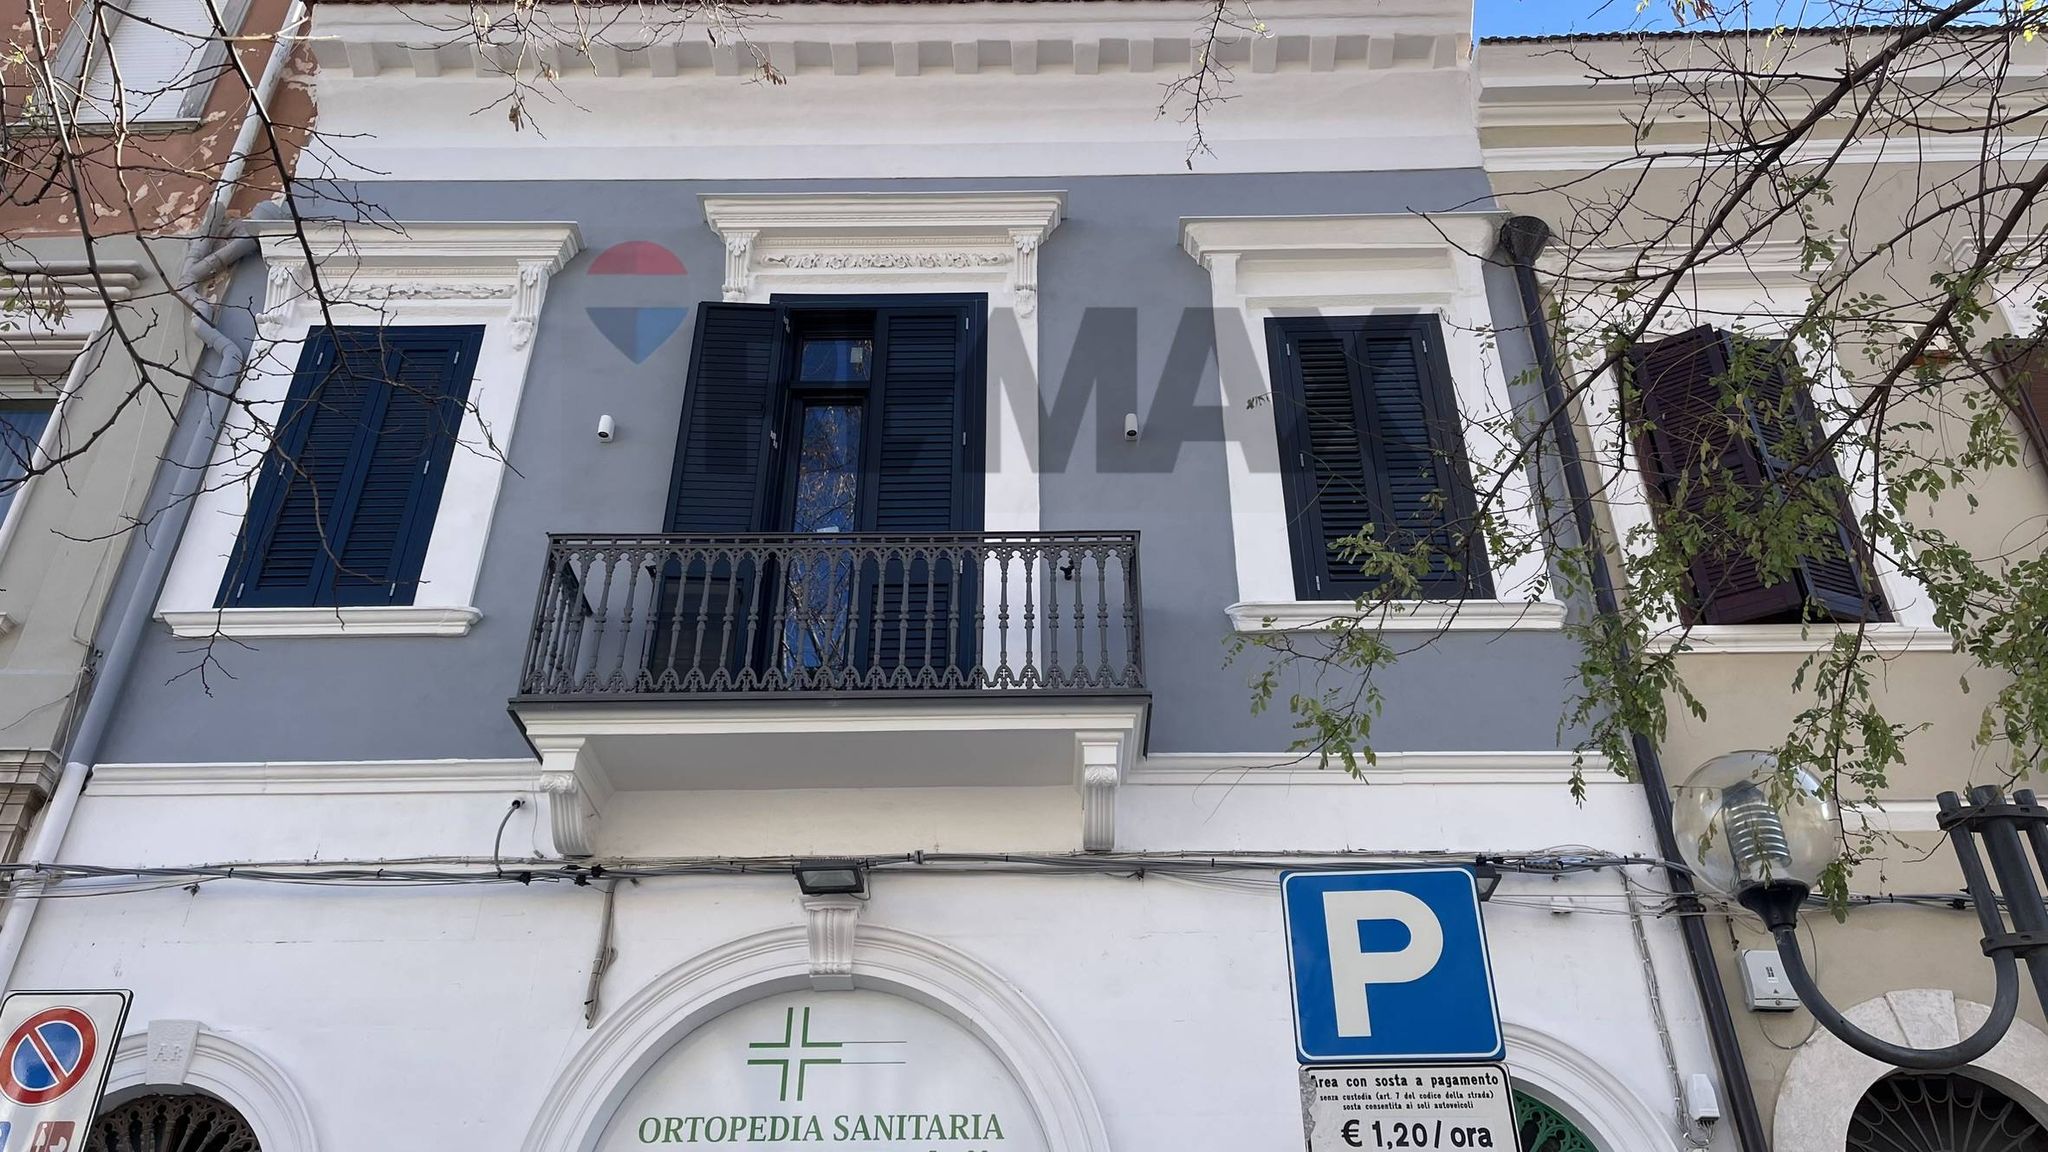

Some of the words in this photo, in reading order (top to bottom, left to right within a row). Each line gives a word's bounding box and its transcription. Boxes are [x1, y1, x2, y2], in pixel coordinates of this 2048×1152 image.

[1322, 890, 1443, 1037] P
[1346, 1077, 1367, 1087] con
[1375, 1074, 1408, 1087] sosta
[1416, 1077, 1423, 1086] a
[1431, 1072, 1498, 1088] pagamento
[1342, 1092, 1372, 1101] custodia
[1395, 1092, 1400, 1100] 7
[1420, 1091, 1441, 1099] codice
[1445, 1091, 1464, 1099] della
[1468, 1090, 1494, 1099] strada)
[1365, 1102, 1402, 1110] consentita
[1406, 1101, 1413, 1109] ai
[1417, 1101, 1430, 1109] soli
[1434, 1101, 1474, 1109] autoveicoli
[638, 1115, 824, 1144] ORTOPEDIA
[833, 1113, 1004, 1142] SANITARIA
